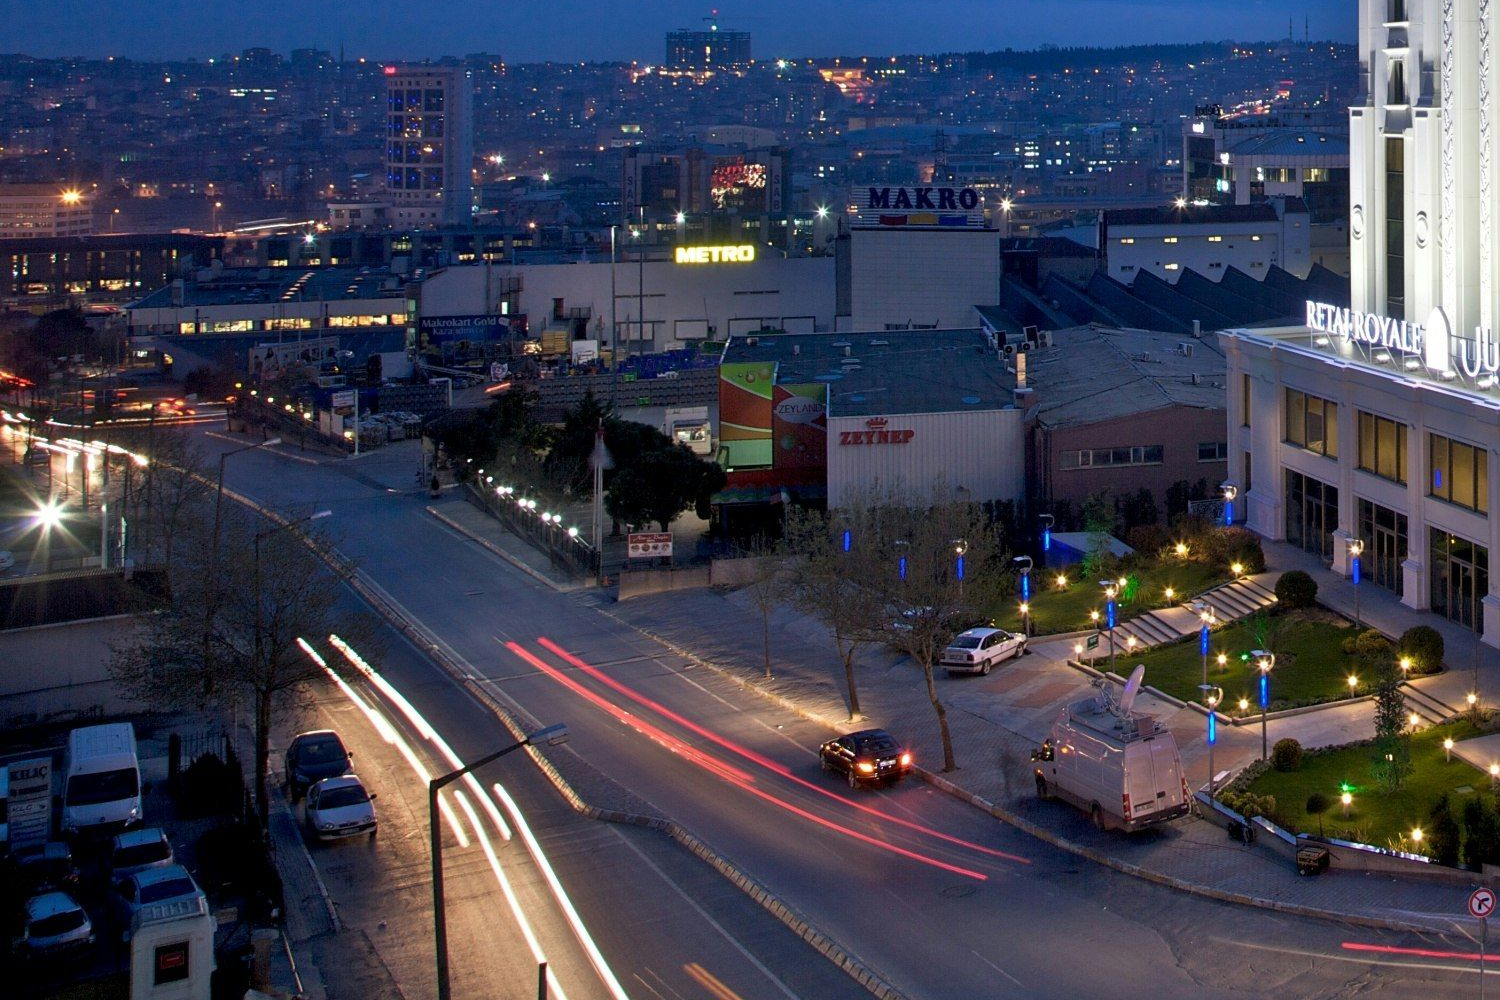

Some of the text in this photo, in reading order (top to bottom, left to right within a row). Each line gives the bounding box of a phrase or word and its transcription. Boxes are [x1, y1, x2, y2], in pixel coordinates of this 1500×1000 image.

[868, 187, 979, 210] MAKRO
[675, 245, 755, 264] METRO
[421, 316, 497, 328] Makrokart Gold
[1306, 300, 1422, 355] RETAJ ROYALE
[778, 403, 823, 414] ZEYLAND
[840, 430, 915, 446] ZEYNEP
